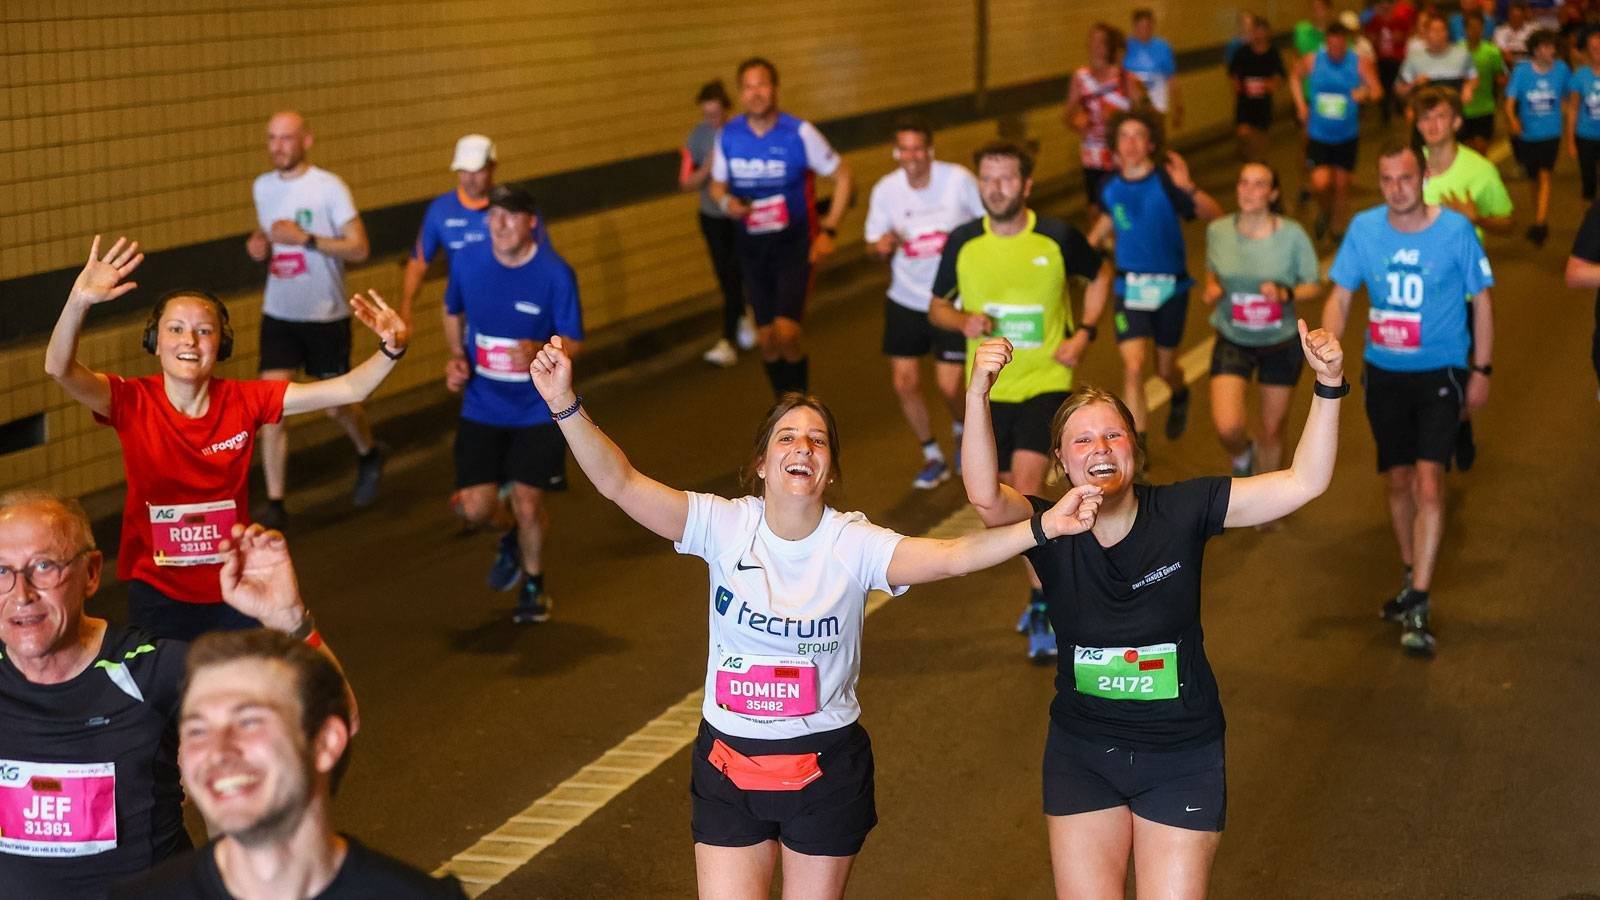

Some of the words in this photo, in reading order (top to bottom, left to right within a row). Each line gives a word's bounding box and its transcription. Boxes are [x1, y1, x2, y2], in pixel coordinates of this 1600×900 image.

[1386, 271, 1424, 309] 10
[211, 430, 249, 453] Fagron
[155, 508, 176, 519] AG
[168, 524, 222, 542] ROZEL
[737, 600, 839, 639] tectum
[797, 640, 839, 656] group
[1080, 649, 1105, 661] AG
[722, 656, 744, 669] AG
[729, 679, 800, 699] DOMIEN
[1097, 676, 1154, 693] 2472
[746, 699, 784, 712] 35482
[22, 795, 72, 821] JEF
